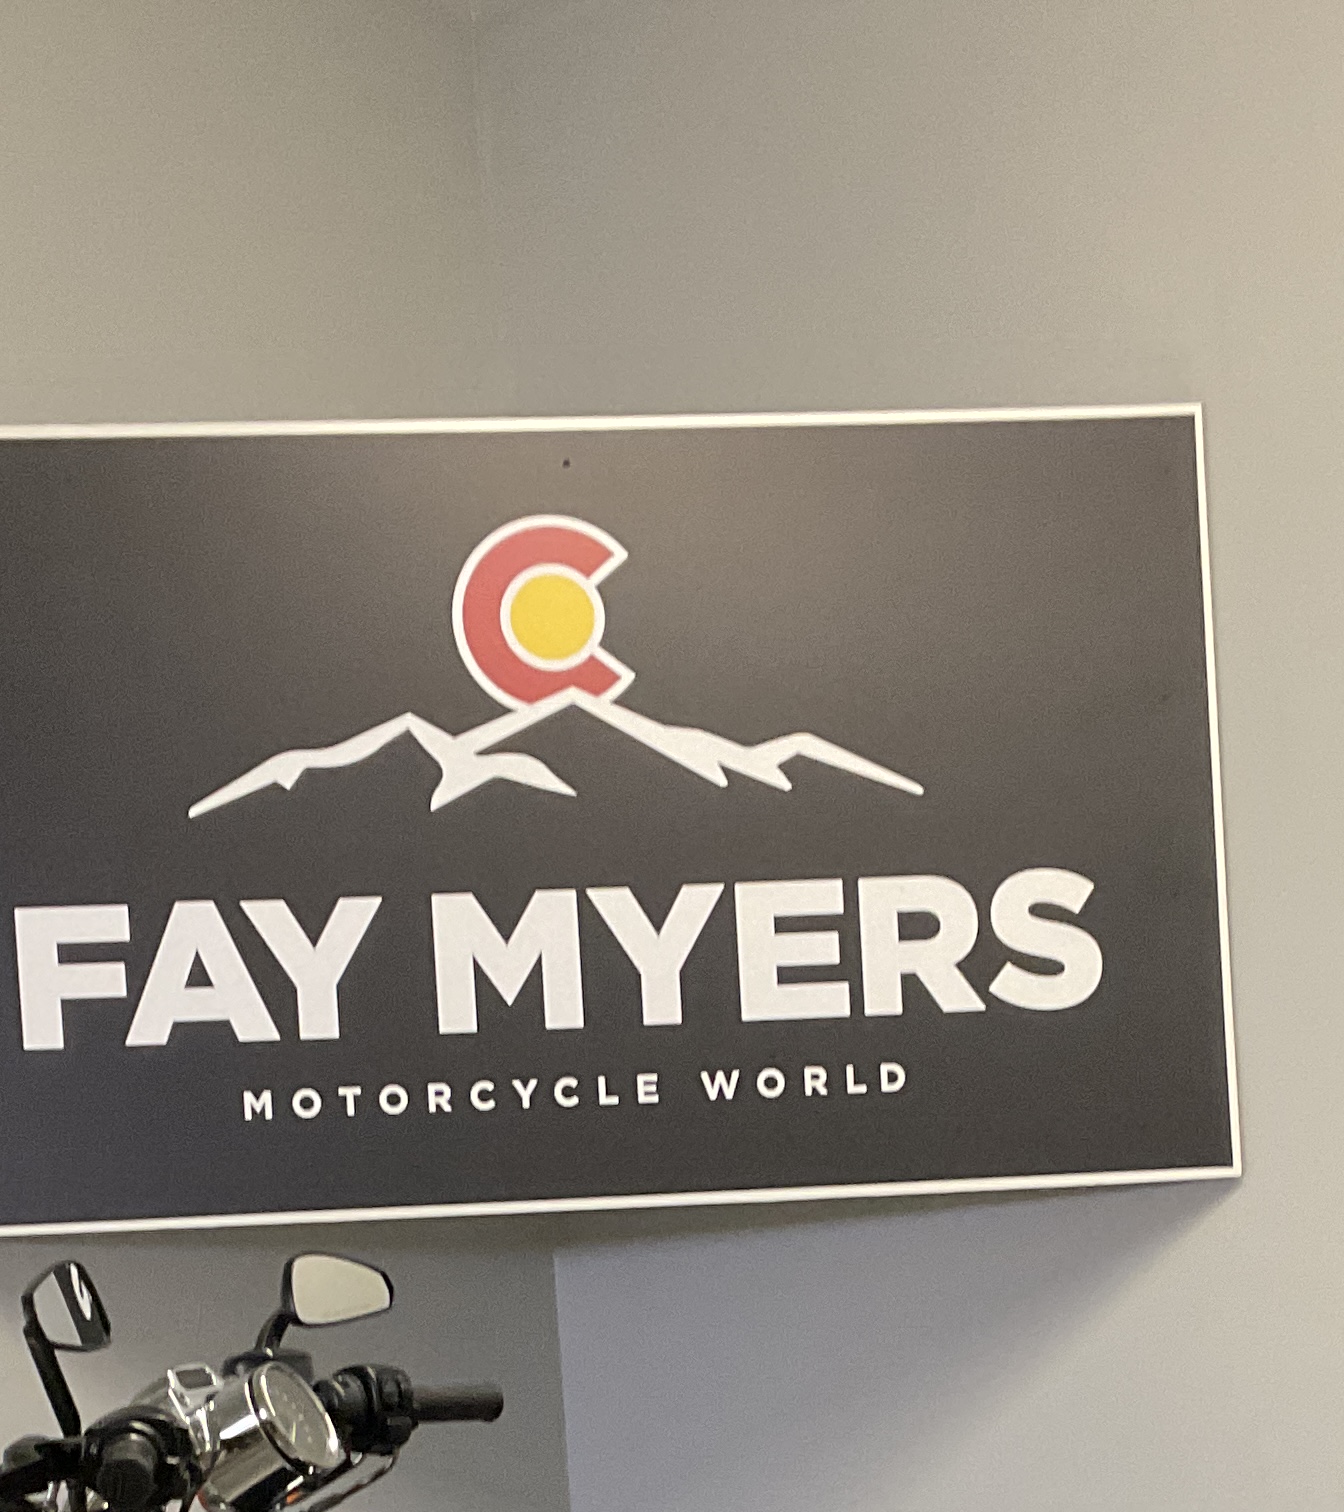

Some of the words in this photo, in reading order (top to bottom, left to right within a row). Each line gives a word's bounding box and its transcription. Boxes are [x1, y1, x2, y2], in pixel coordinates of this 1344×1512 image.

[14, 896, 382, 1050] FAY
[431, 868, 1102, 1034] MYERS
[244, 1073, 659, 1121] MOTORCYCLE
[701, 1063, 905, 1100] WORLD
